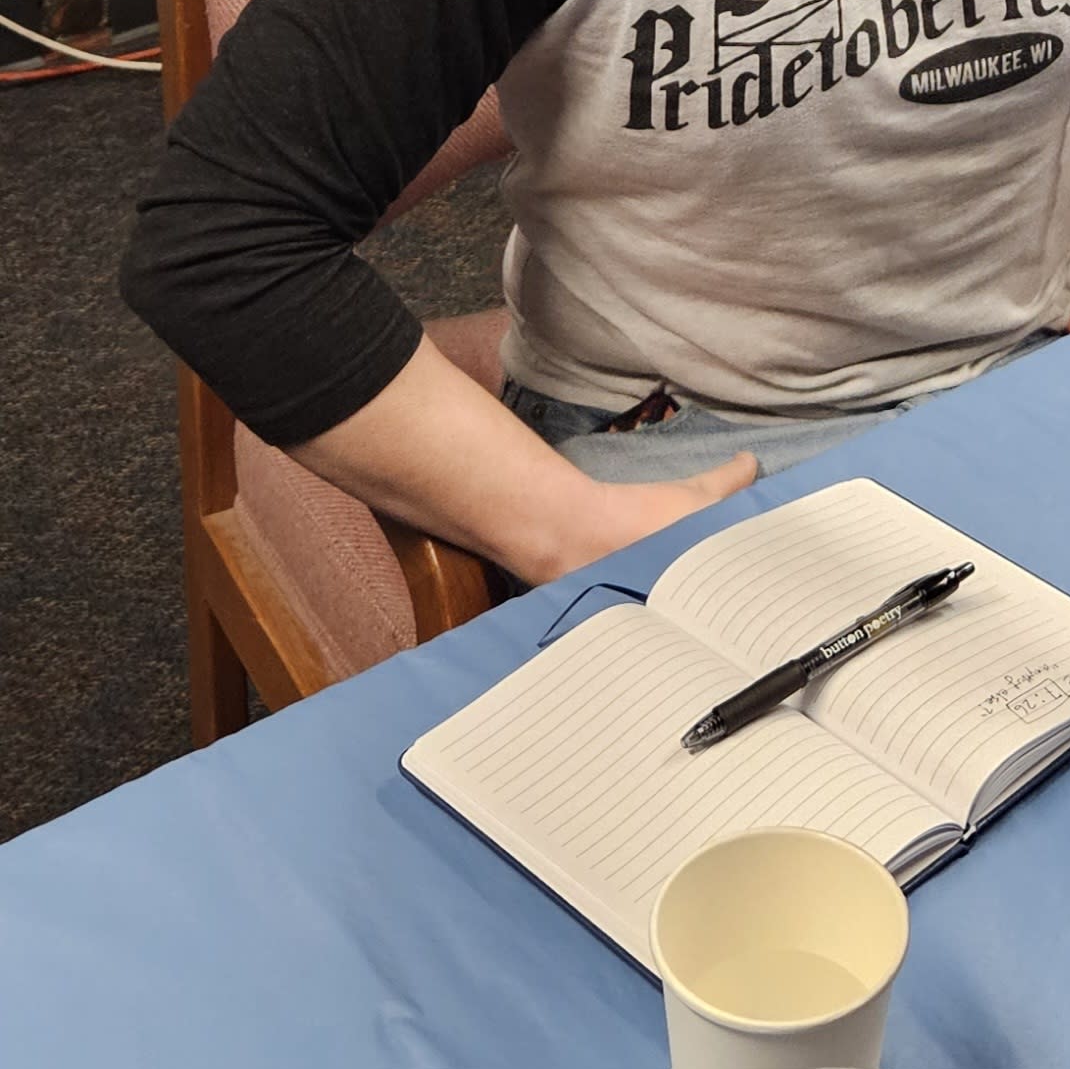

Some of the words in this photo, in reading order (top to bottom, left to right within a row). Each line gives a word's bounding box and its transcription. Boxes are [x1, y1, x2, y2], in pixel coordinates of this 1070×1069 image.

[1030, 39, 1053, 64] WI
[820, 628, 865, 659] button
[862, 605, 902, 639] poetry
